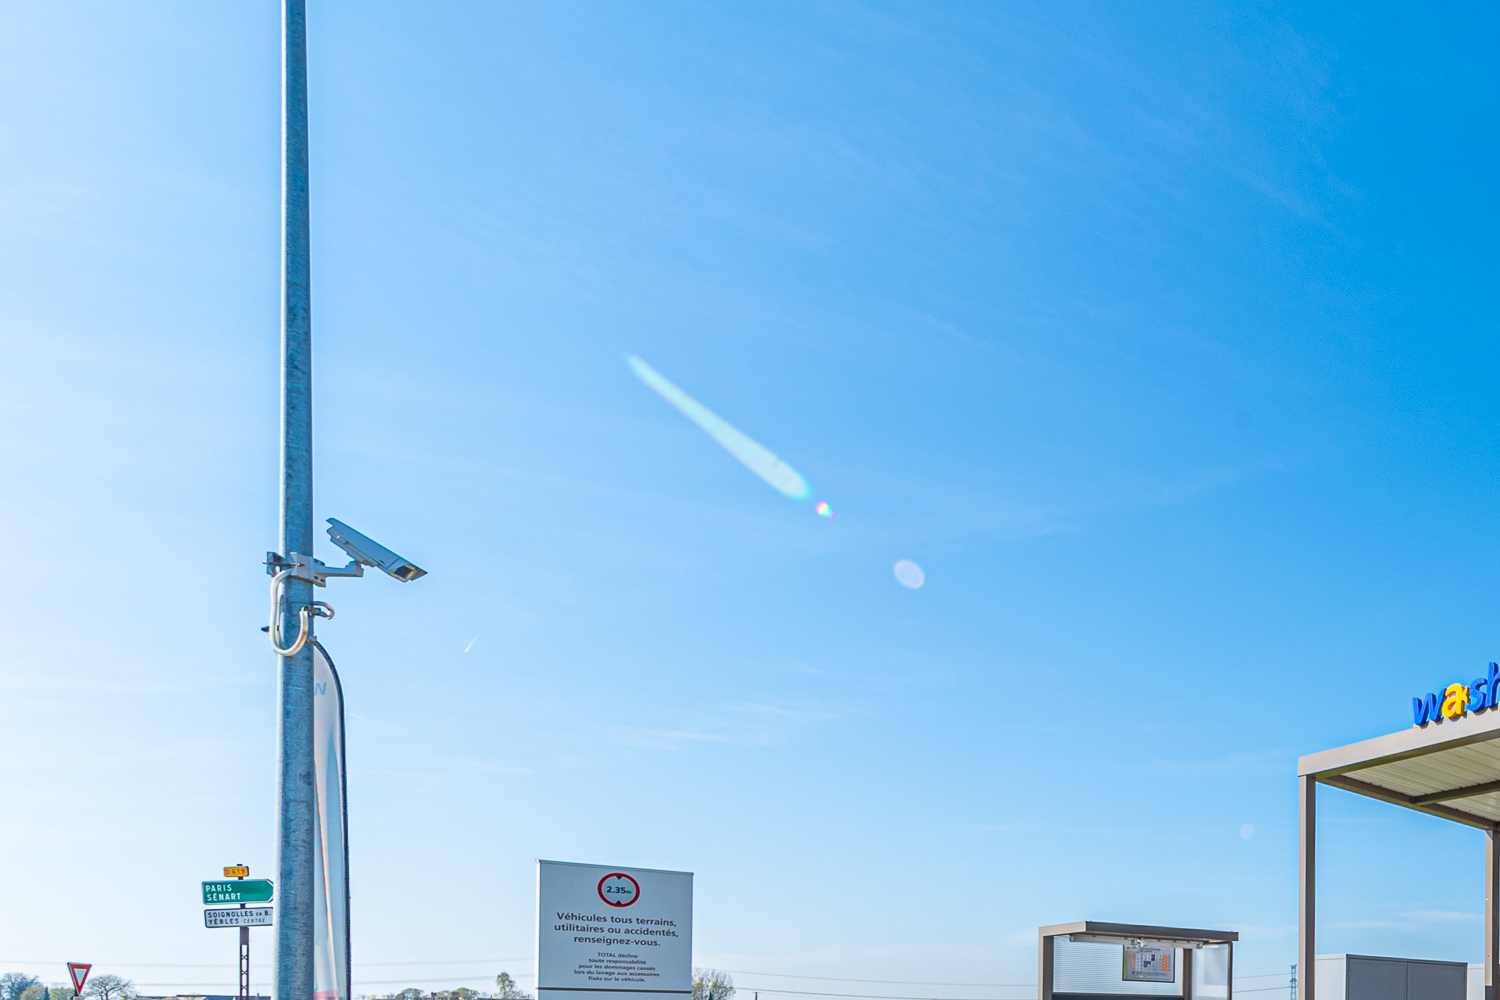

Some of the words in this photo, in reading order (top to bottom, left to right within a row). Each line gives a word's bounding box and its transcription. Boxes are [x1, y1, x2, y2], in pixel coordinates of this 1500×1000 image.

[207, 893, 241, 901] SÉNART
[557, 912, 607, 922] Véhicules
[610, 916, 633, 924] tous
[636, 917, 677, 927] terrains,
[554, 924, 604, 933] utilitaires
[624, 927, 679, 938] accidentés,
[574, 936, 660, 946] renseignez-vous.
